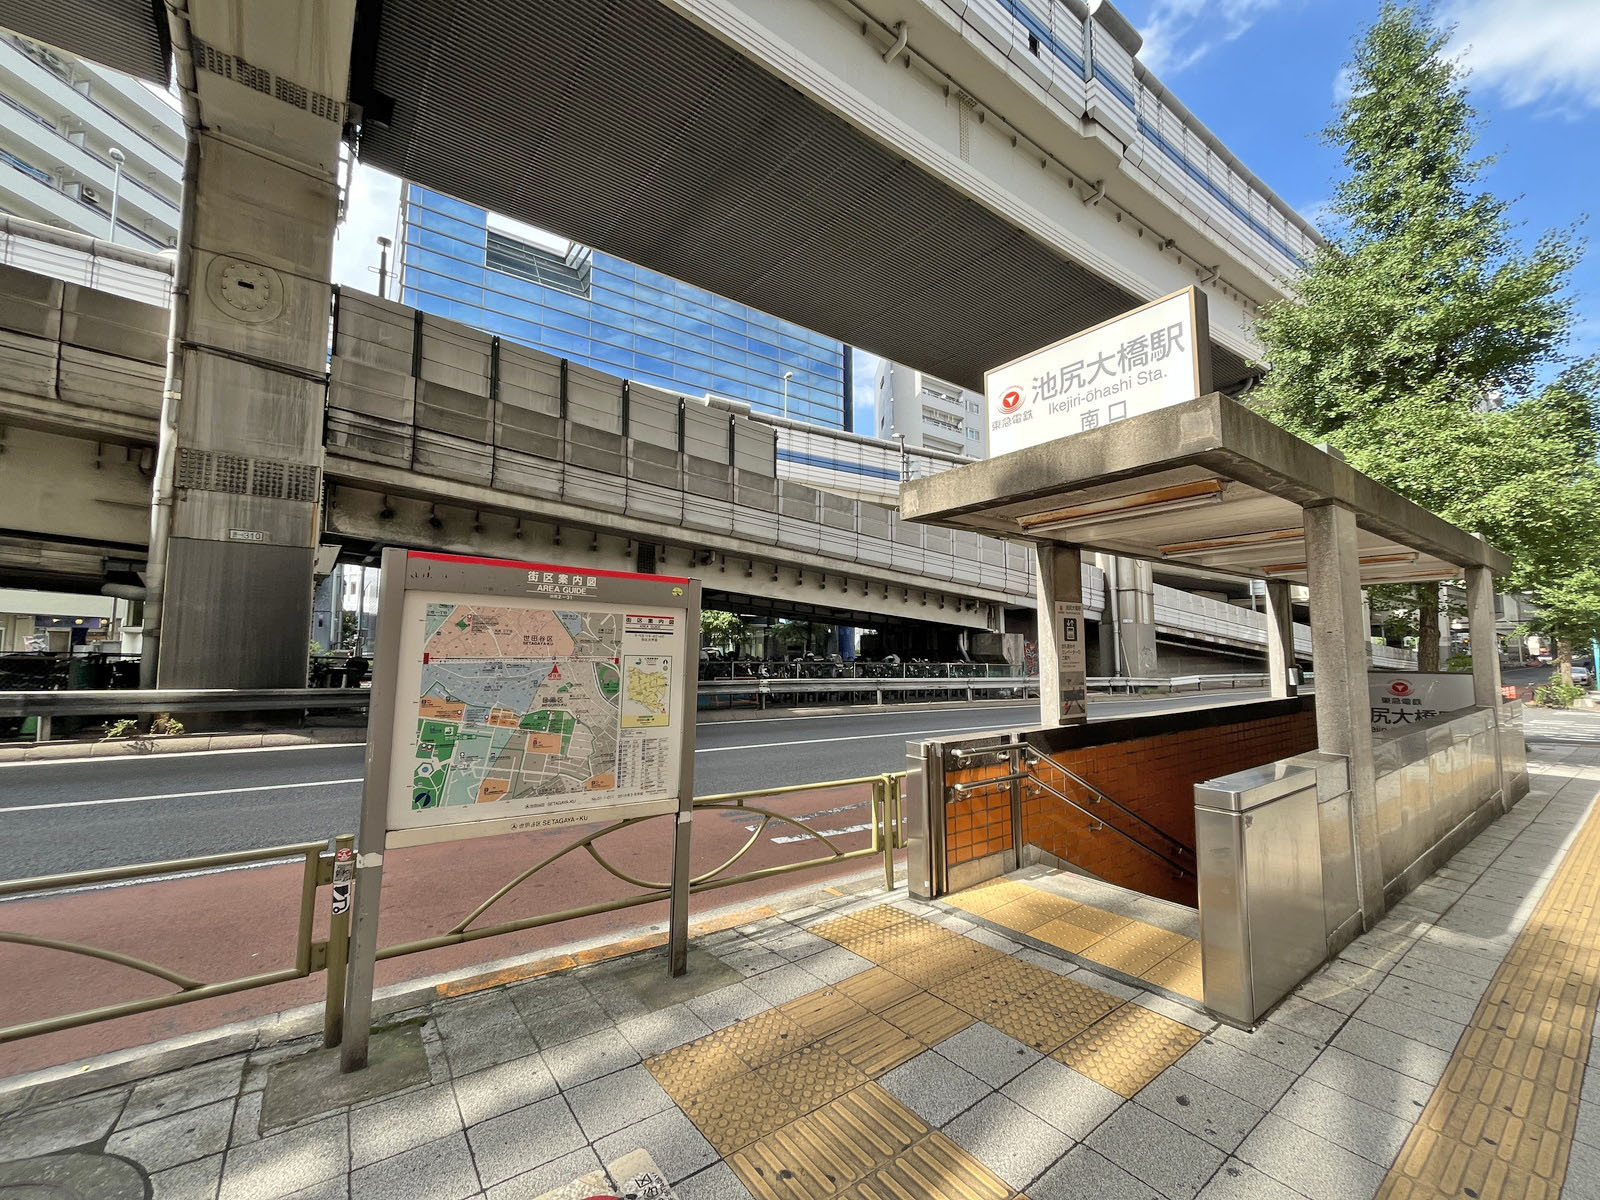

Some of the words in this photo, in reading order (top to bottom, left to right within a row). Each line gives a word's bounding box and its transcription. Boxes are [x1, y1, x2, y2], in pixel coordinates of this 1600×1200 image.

[1031, 321, 1185, 405] 池尻大橋駅
[1048, 376, 1132, 415] Ikejiri-ōhashi
[1137, 369, 1168, 387] Sta.
[991, 410, 1034, 431] 東急電鉄
[1080, 400, 1128, 432] 南口
[527, 571, 597, 587] 街区案内図
[537, 585, 560, 593] AREA
[562, 587, 587, 595] GUIDE
[1381, 697, 1422, 705] 東急電鉄
